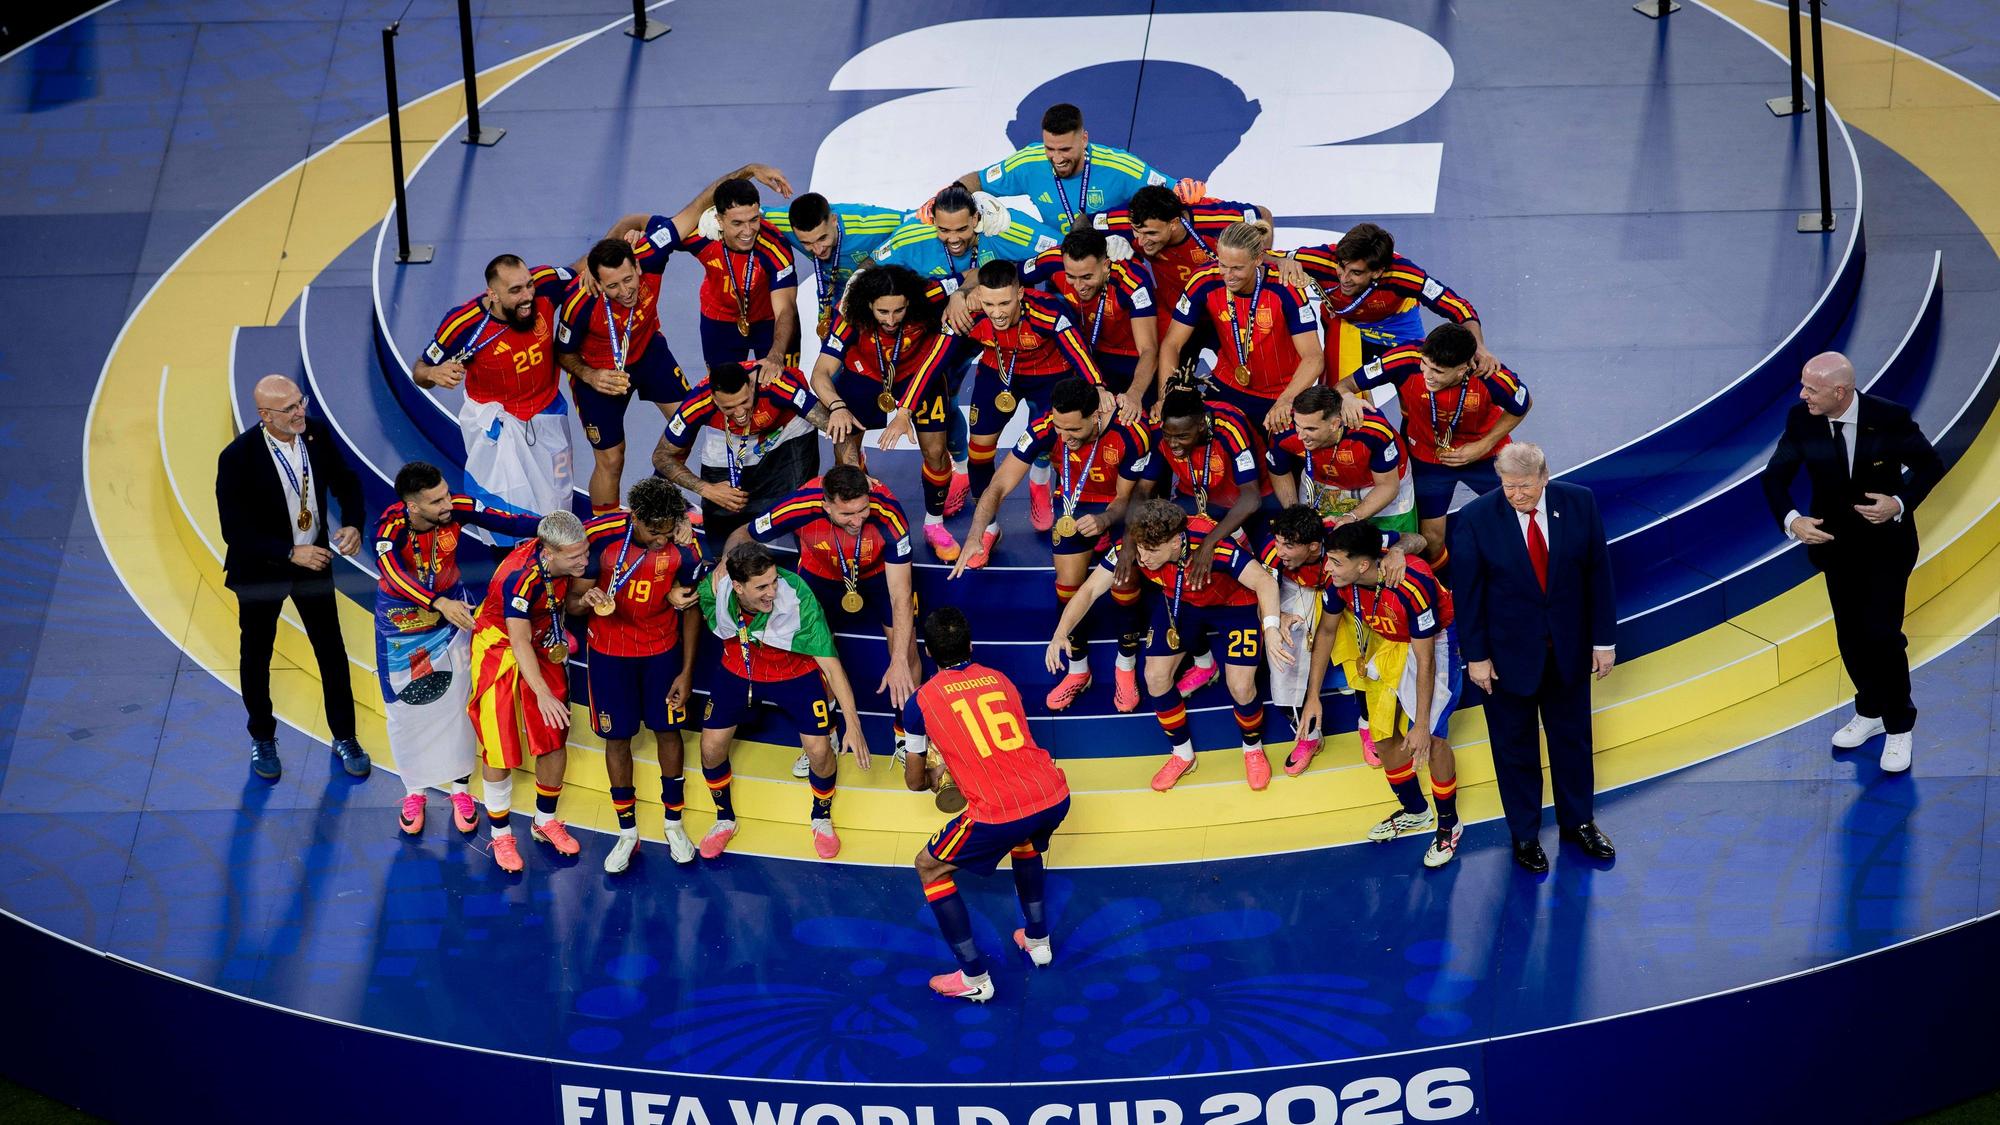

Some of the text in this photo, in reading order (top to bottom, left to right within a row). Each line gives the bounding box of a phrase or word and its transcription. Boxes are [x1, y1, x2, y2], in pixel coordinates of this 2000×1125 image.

[1177, 265, 1191, 281] 2
[513, 343, 543, 373] 26
[915, 396, 946, 425] 24
[1090, 467, 1104, 482] 6
[628, 579, 651, 602] 19
[1365, 615, 1397, 634] 20
[1228, 629, 1258, 657] 25
[943, 675, 999, 695] RODRIGO
[812, 700, 829, 728] 9
[951, 691, 1025, 759] 16
[561, 1084, 711, 1125] FIFA
[1200, 1067, 1474, 1125] 2026
